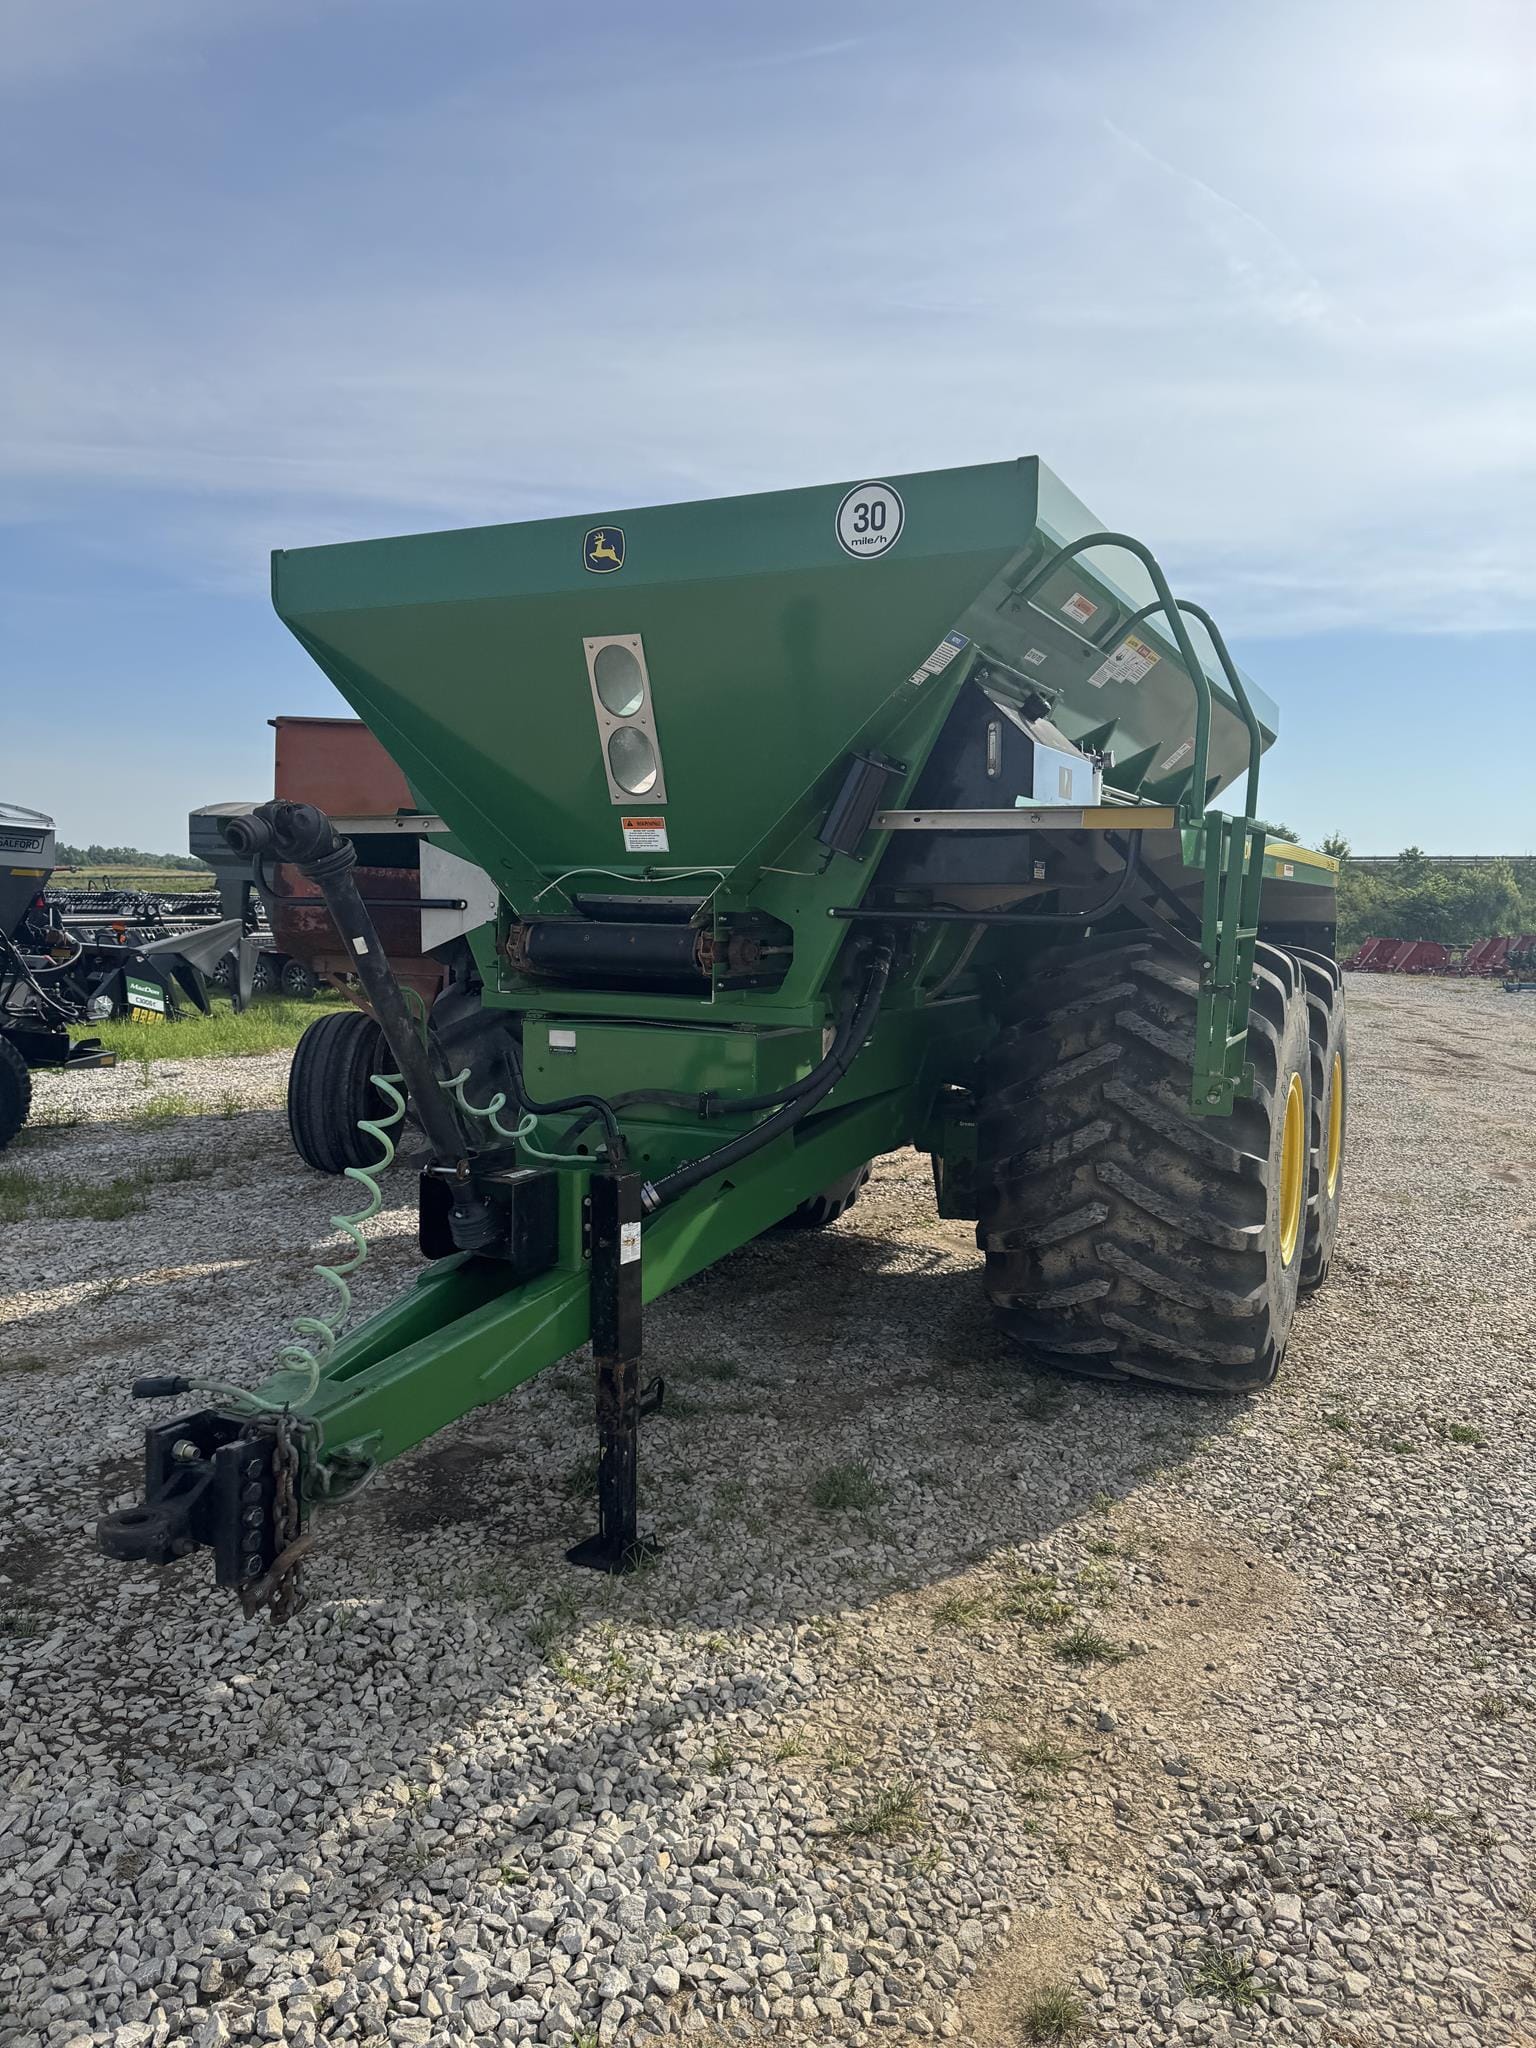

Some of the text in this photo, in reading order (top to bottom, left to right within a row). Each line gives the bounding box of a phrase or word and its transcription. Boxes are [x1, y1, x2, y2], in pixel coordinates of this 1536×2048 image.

[853, 501, 886, 533] 30
[851, 535, 887, 546] mile/h
[130, 983, 160, 995] MacDon
